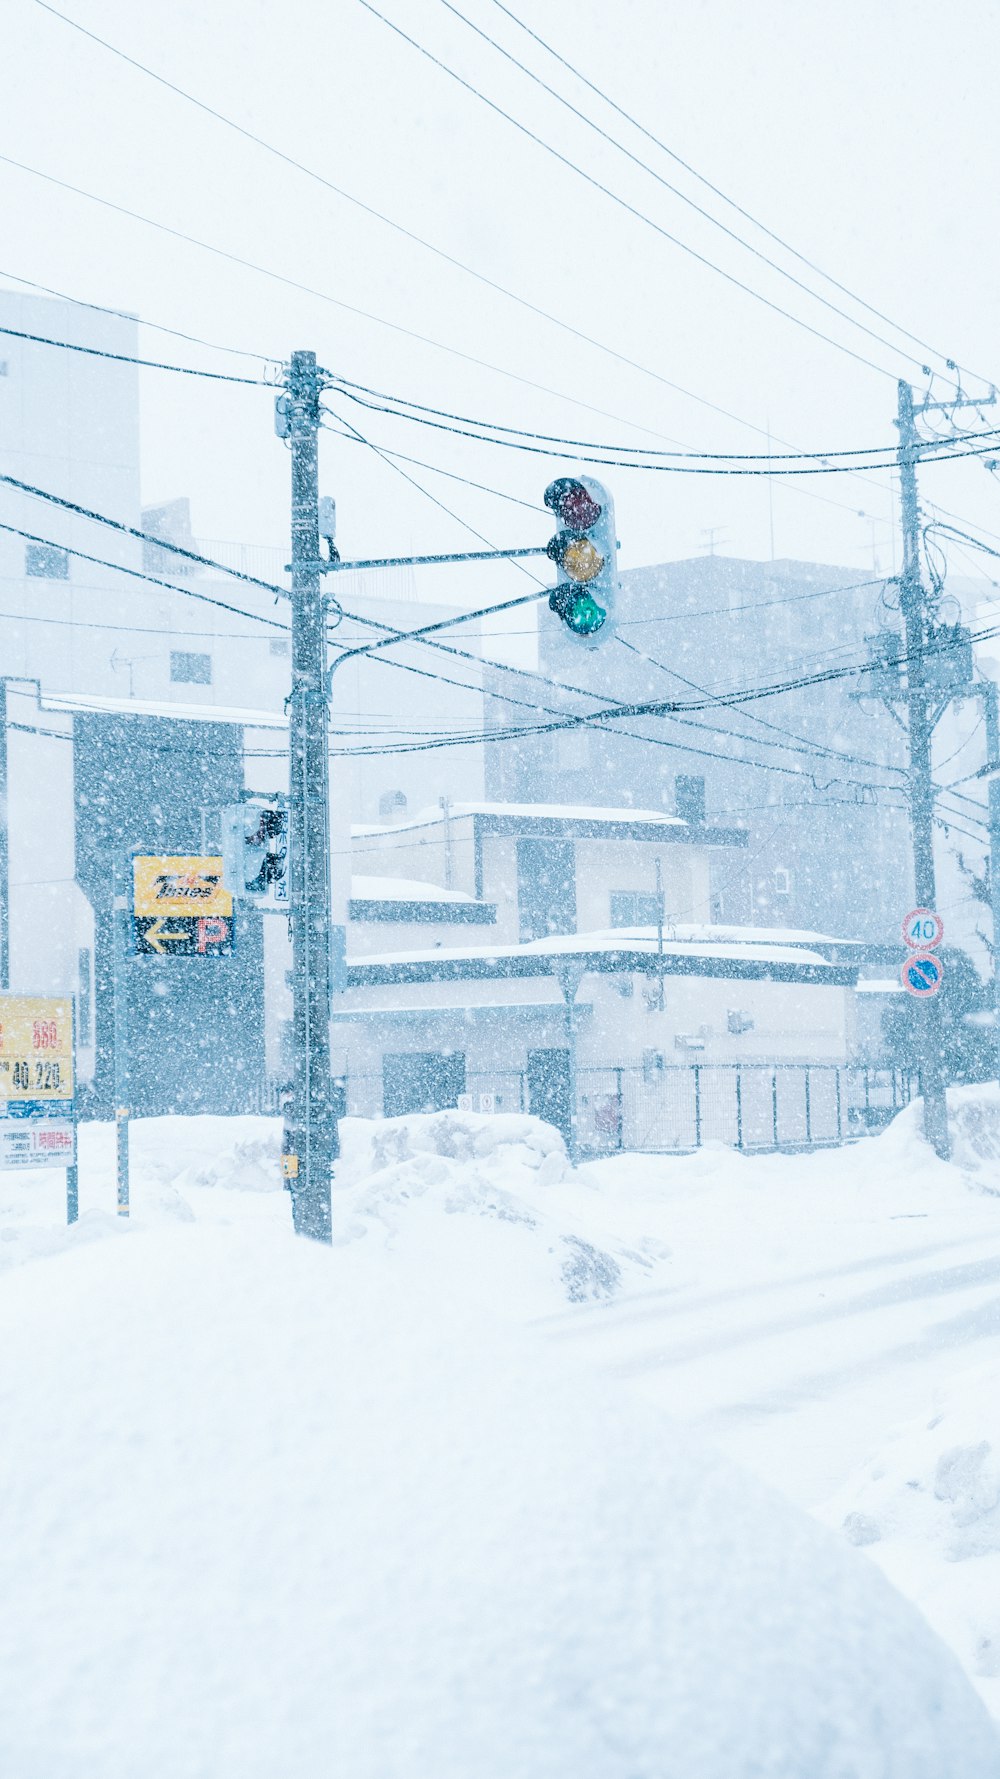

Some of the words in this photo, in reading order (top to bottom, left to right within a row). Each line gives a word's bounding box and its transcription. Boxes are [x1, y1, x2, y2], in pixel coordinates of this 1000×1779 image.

[154, 875, 220, 899] Times
[197, 919, 227, 952] P
[911, 920, 935, 939] 40
